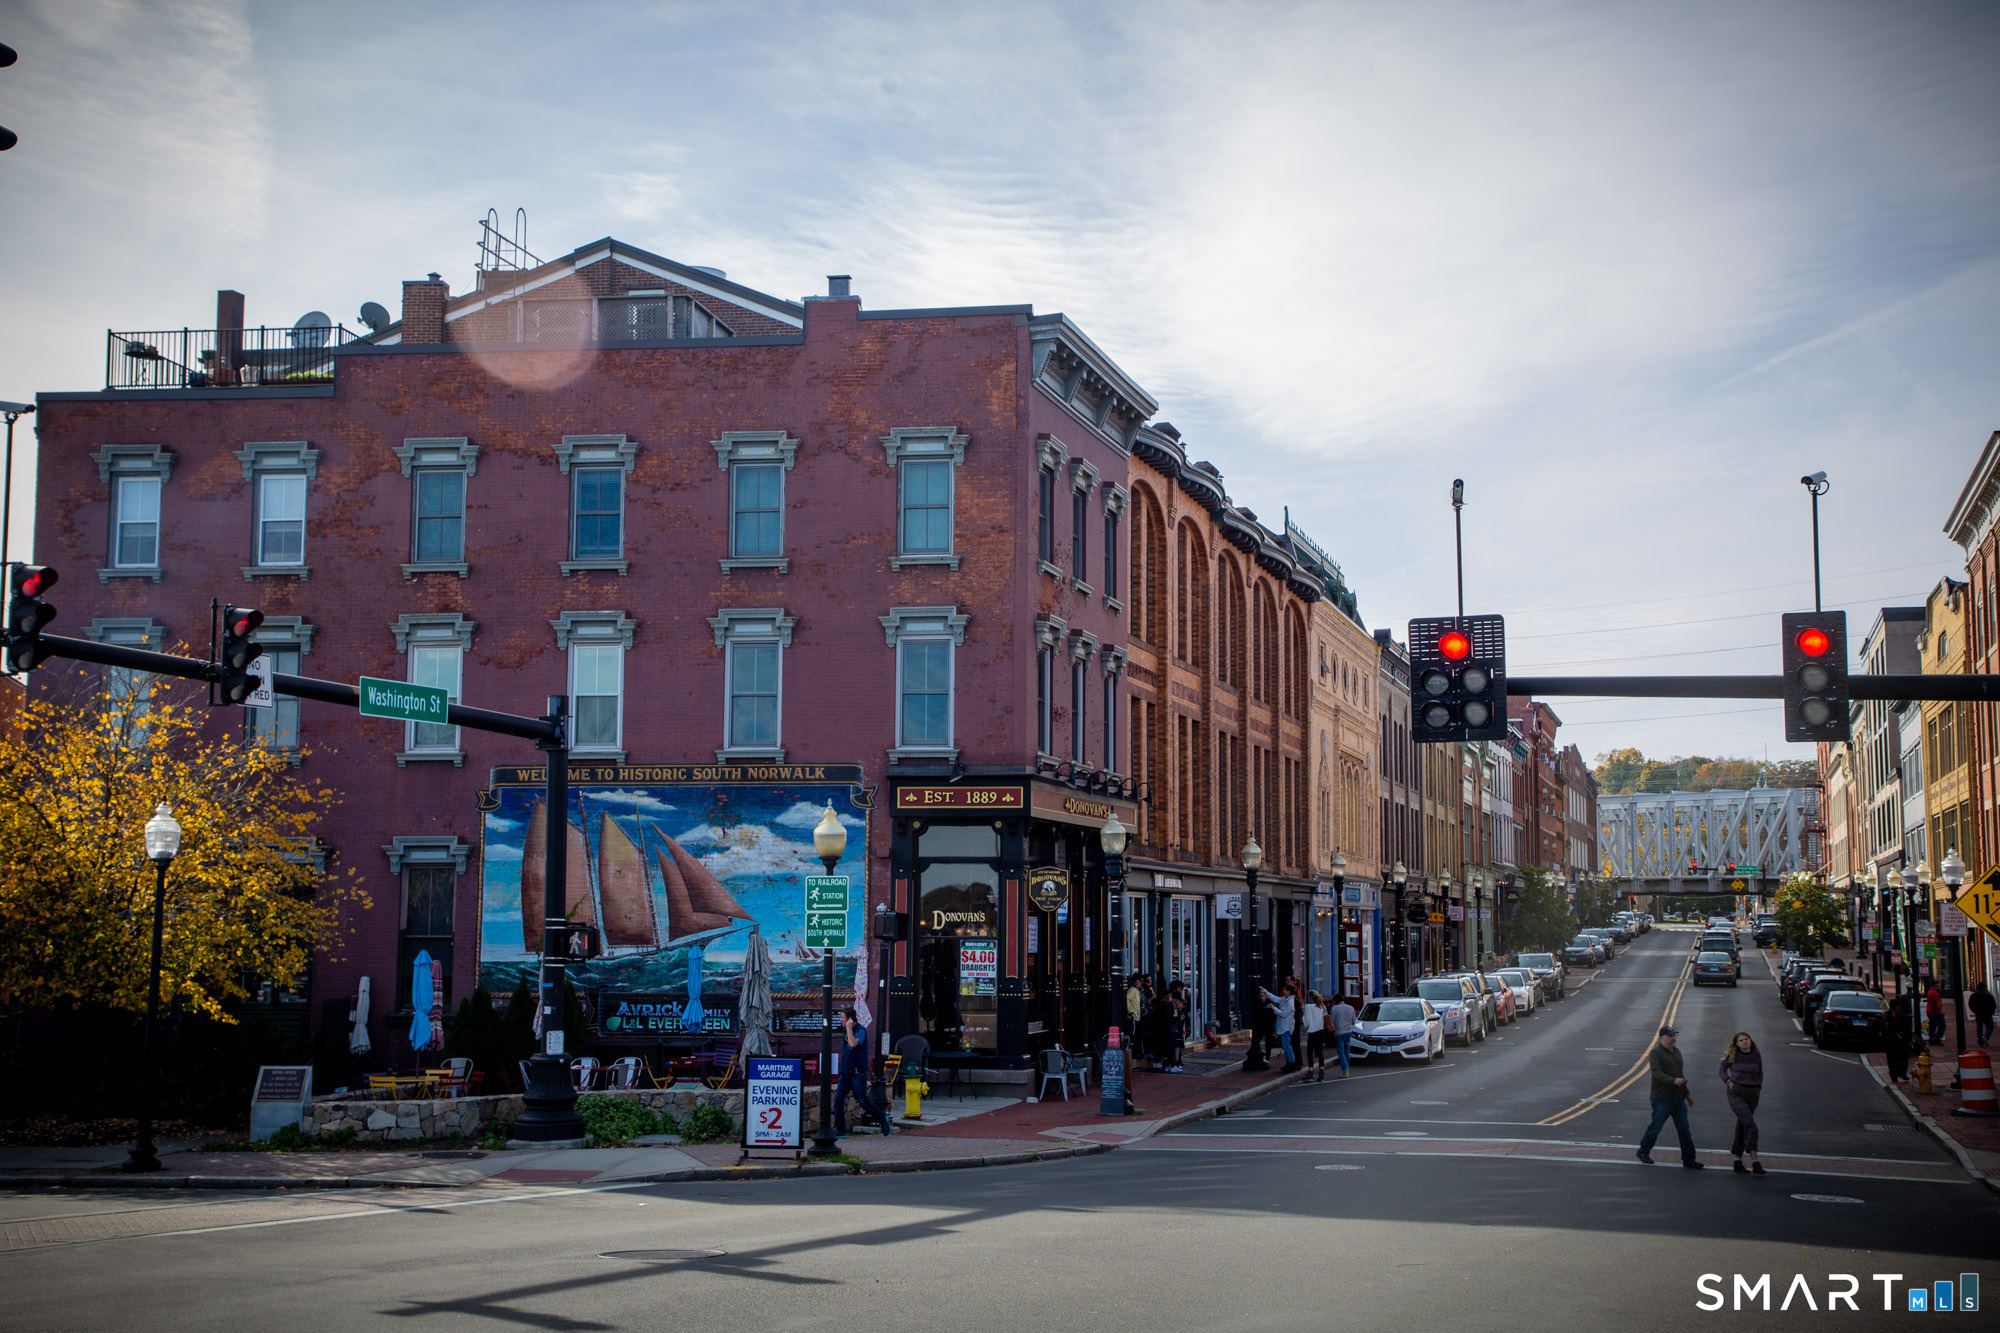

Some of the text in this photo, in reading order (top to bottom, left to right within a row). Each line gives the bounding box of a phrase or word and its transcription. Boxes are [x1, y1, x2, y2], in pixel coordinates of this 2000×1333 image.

[254, 689, 270, 701] RED
[368, 686, 441, 715] Washington St
[516, 766, 826, 782] WELME TO HISTORIC SOUTH NORWALK
[923, 790, 998, 804] EST. 1889
[1069, 798, 1108, 818] DONOVAN'S
[807, 878, 847, 886] TO RAILROAD
[822, 892, 844, 900] STATION
[821, 918, 843, 926] HISTORIC
[932, 909, 986, 930] DONOVAN'S
[807, 929, 845, 937] SOUTH NORWALK
[961, 950, 995, 963] $4.00
[961, 963, 996, 972] DRAUGHTS
[622, 1017, 731, 1030] L&L EVEREEN
[757, 1064, 794, 1072] MARITIME
[760, 1071, 791, 1079] GARAGE
[752, 1085, 798, 1095] EVENING
[751, 1096, 798, 1106] PARKING
[759, 1107, 783, 1130] $2
